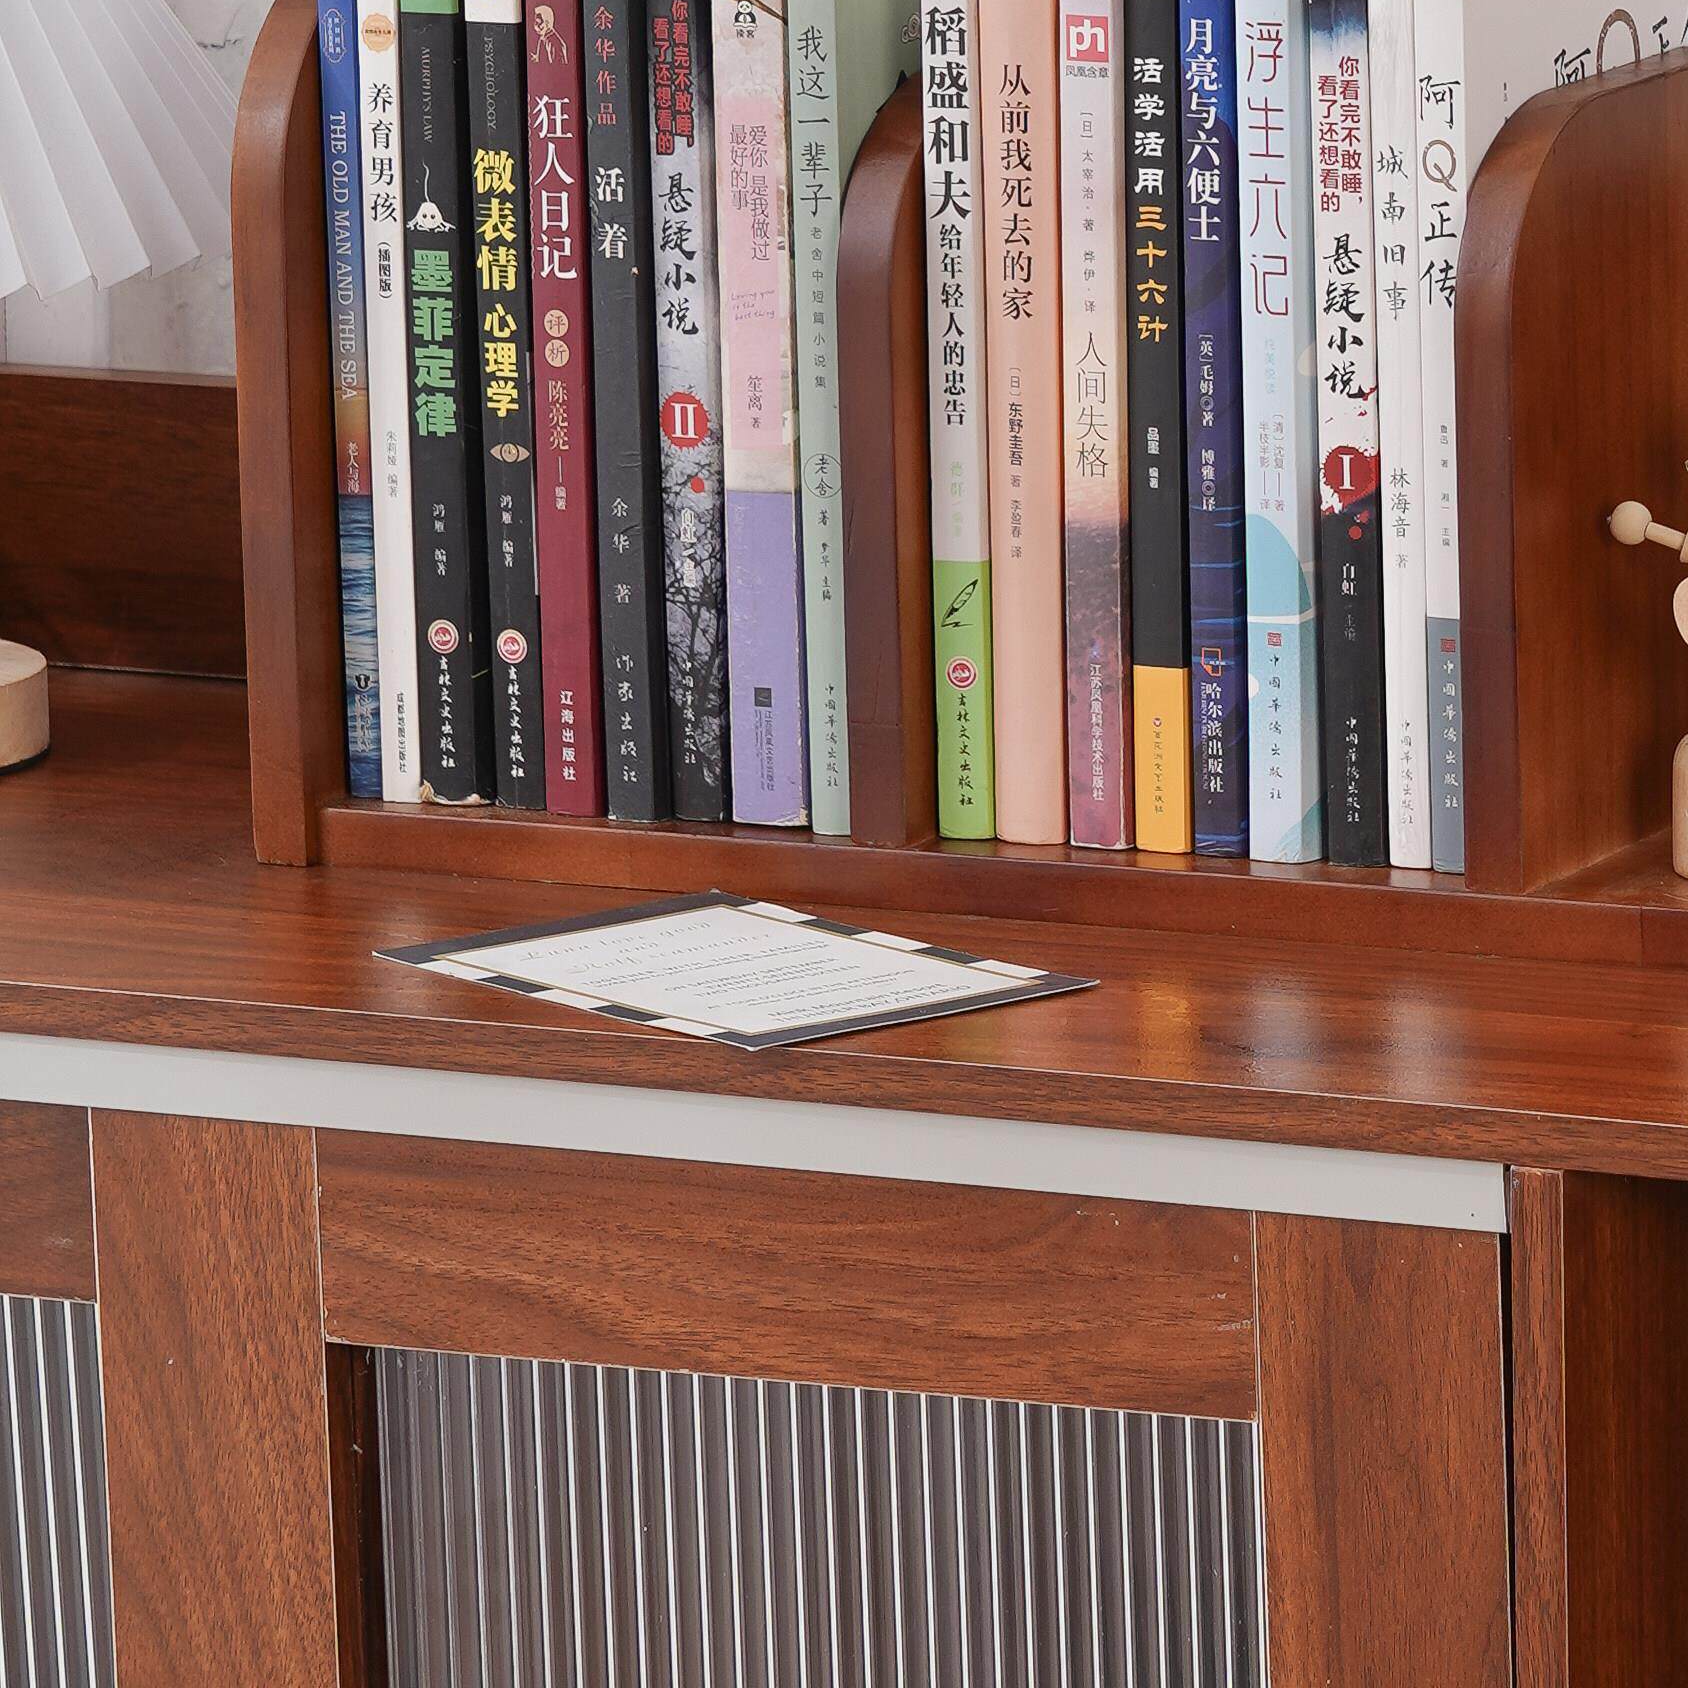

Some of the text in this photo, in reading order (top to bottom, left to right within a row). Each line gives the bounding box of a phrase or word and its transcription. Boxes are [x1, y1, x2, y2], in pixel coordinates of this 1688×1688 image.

[594, 6, 616, 125] 余华作品
[653, 16, 675, 155] 看了还想看的
[797, 25, 832, 217] 我这一辈子
[924, 6, 972, 220] 稻盛和夫
[1066, 65, 1109, 78] 凤凰含章
[1185, 18, 1221, 242] 月亮与六便士
[368, 82, 398, 223] 养育男孩
[532, 94, 577, 279] 狂人日记
[595, 167, 629, 260] 活着
[730, 124, 750, 210] 最好的事
[750, 126, 770, 261] 爱你 是我做过
[999, 64, 1034, 320] 从前我死去的家
[1133, 57, 1169, 343] 活学活用三十六计
[1245, 21, 1288, 316] 浮生六记
[1318, 75, 1340, 212] 看了还想看的
[1419, 74, 1461, 308] 阿Q正传
[330, 111, 355, 354] THE OLD MAN AND THE
[474, 148, 520, 417] 微表情心理学
[659, 172, 699, 335] 悬疑小说
[1377, 144, 1408, 320] 城南旧事
[411, 249, 457, 437] 墨菲定律
[810, 226, 826, 389] 老舍中短篇小说集
[939, 224, 966, 425] 给年轻人的忠告
[1323, 233, 1366, 398] 悬疑小说
[548, 380, 569, 450] 陈亮亮
[815, 455, 833, 496] 老舍
[1076, 332, 1109, 478] 人间失格
[611, 498, 629, 553] 余华
[1389, 467, 1411, 538] 林海音
[435, 656, 456, 768] 吉林文史出版社
[507, 665, 525, 777] 吉林文史出版社
[616, 655, 638, 782] 作家出版社
[825, 683, 839, 787] 中国华侨出版社
[956, 693, 974, 806] 吉林文史出版社
[1089, 664, 1105, 801] 江苏凤凰科学技术出版社
[1206, 683, 1224, 793] 哈尔滨出版社
[1268, 654, 1282, 799] 中国华侨出版社
[1401, 720, 1413, 824] 中国华侨出版社
[1442, 660, 1458, 808] 中国华侨出版社
